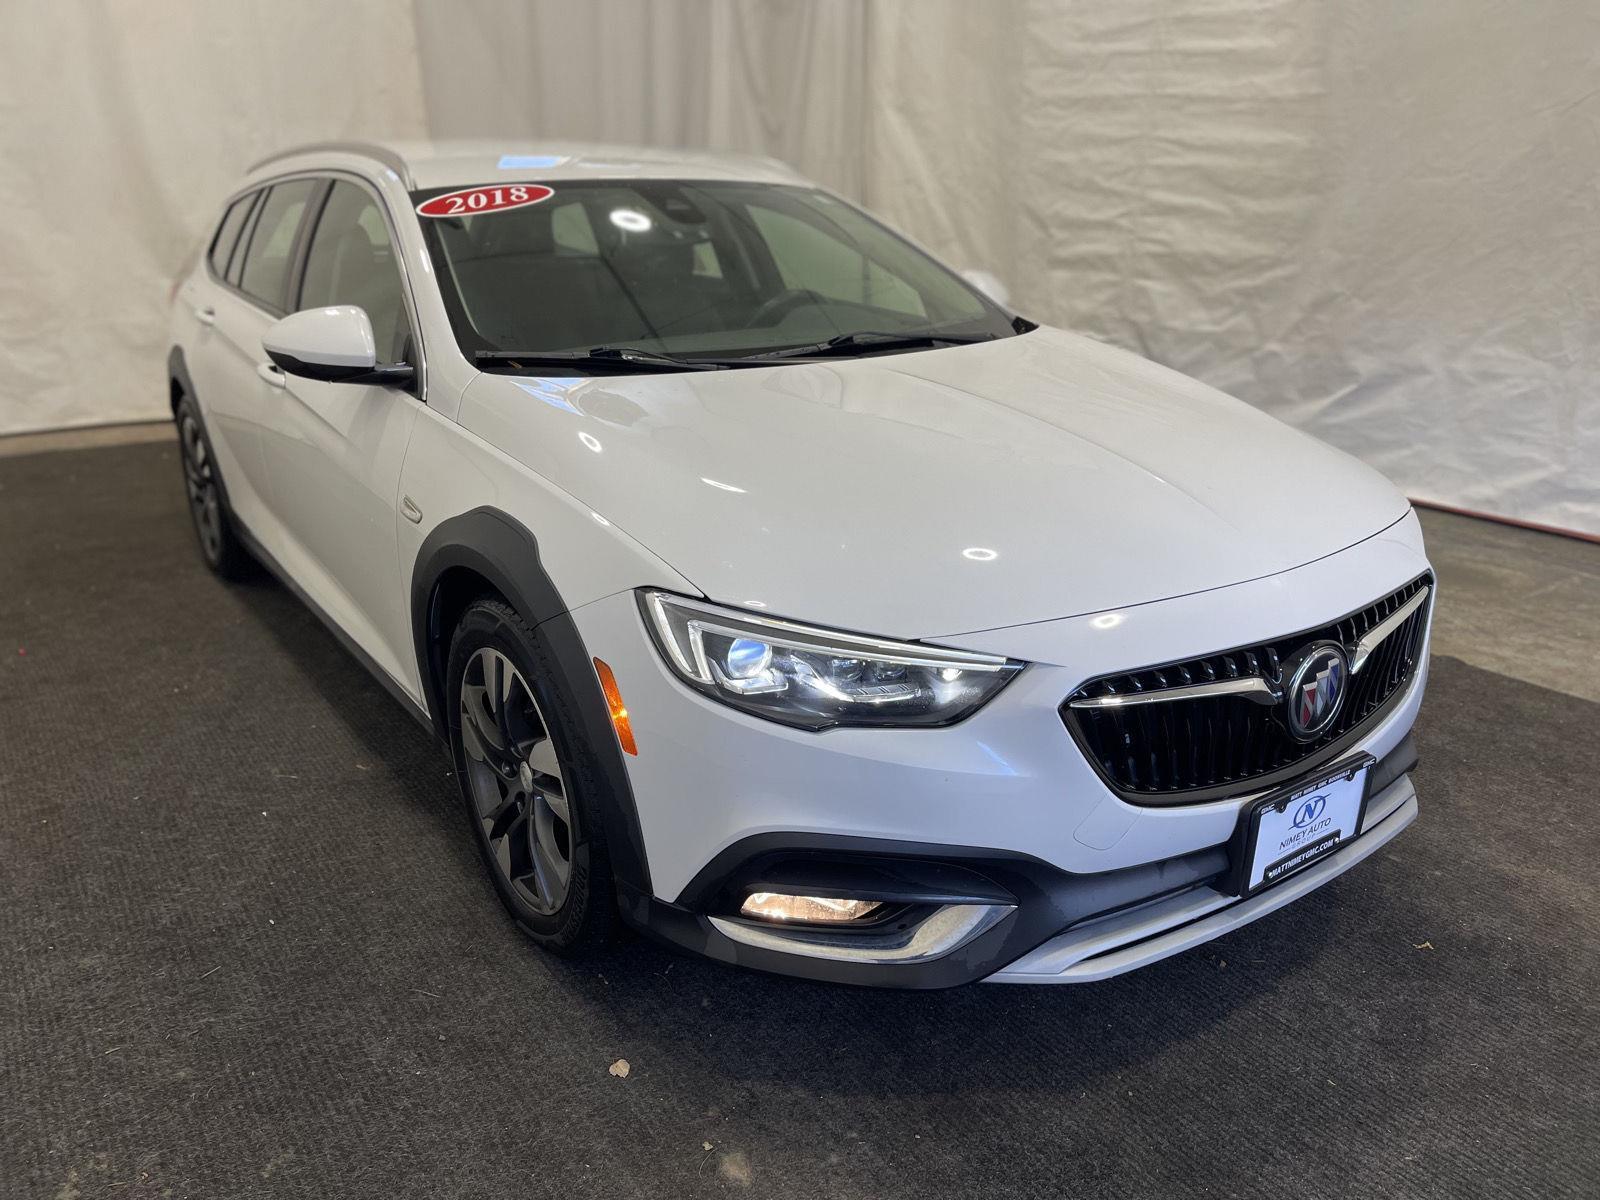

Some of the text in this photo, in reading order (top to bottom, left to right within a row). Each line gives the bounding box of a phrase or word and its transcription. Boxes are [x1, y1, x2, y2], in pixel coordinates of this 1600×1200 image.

[445, 186, 529, 214] 2018
[1279, 817, 1332, 850] NIMEY AUTO
[1271, 838, 1334, 877] MATTNIMEYGMC.COM
